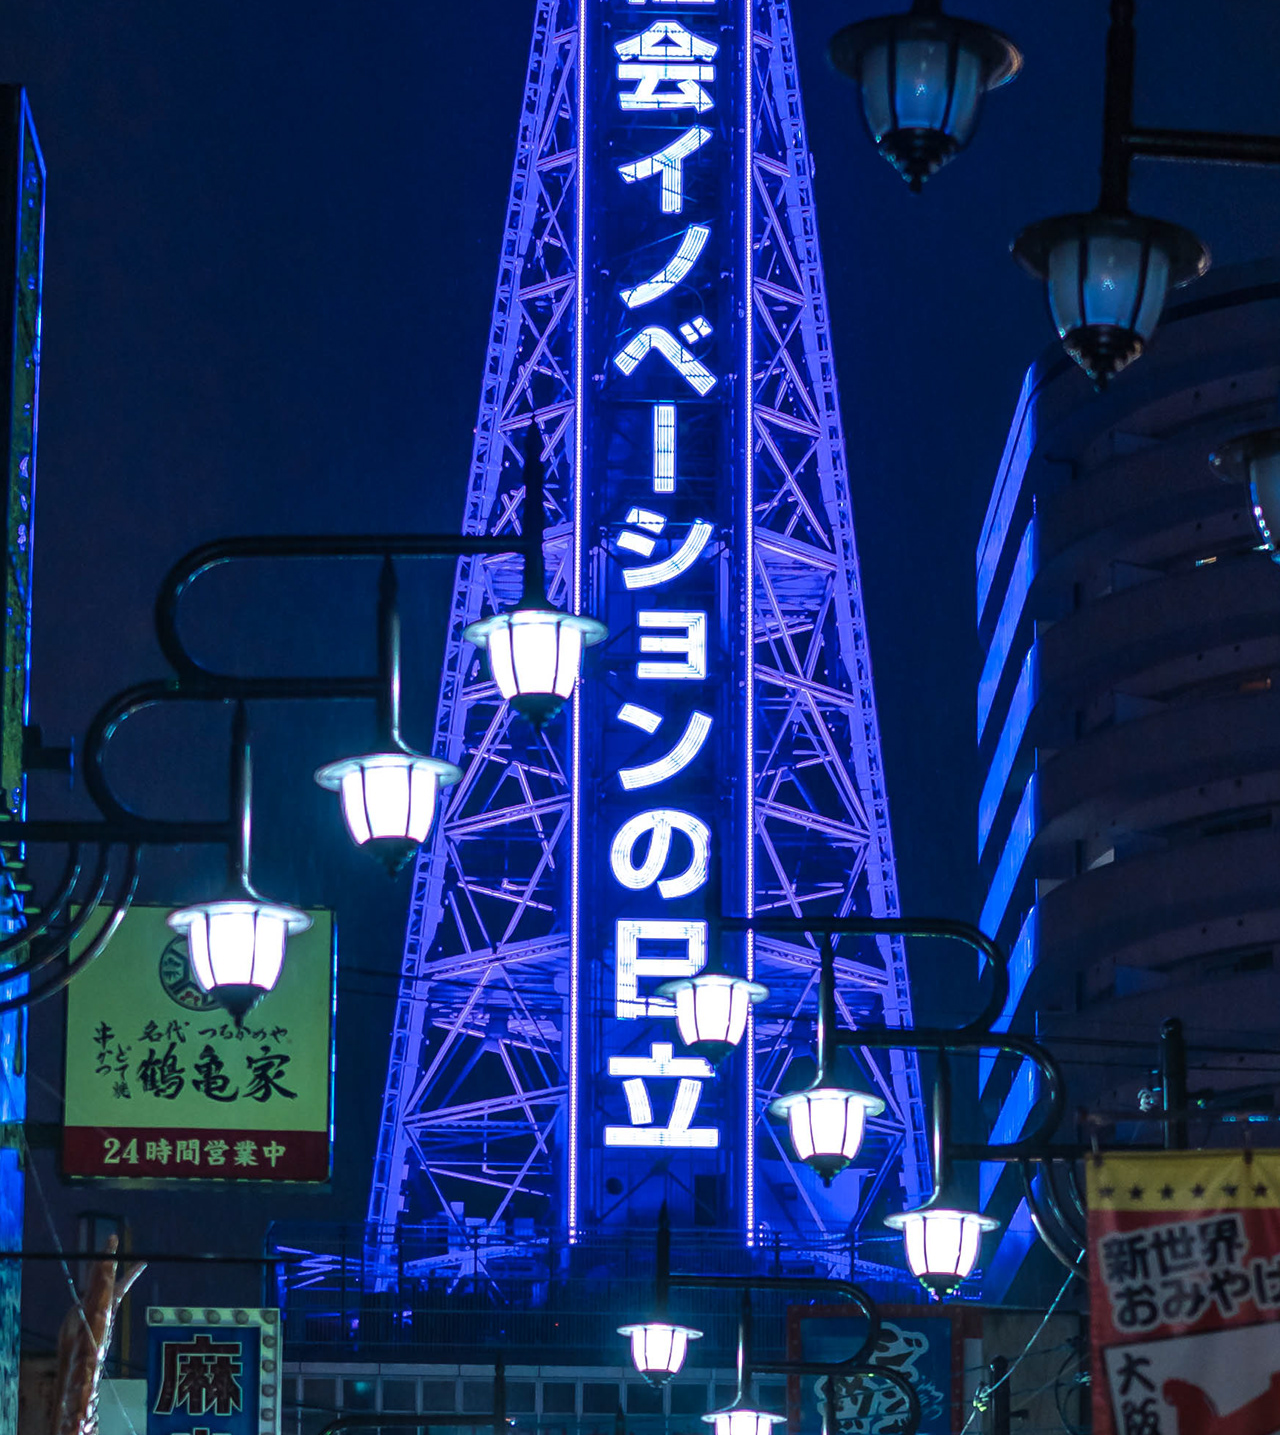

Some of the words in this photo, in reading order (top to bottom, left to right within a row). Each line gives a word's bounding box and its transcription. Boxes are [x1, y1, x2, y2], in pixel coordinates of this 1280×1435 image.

[137, 1043, 298, 1102] 鶴亀家
[104, 1137, 287, 1168] 24時間営業中
[1104, 1218, 1244, 1282] 新世界
